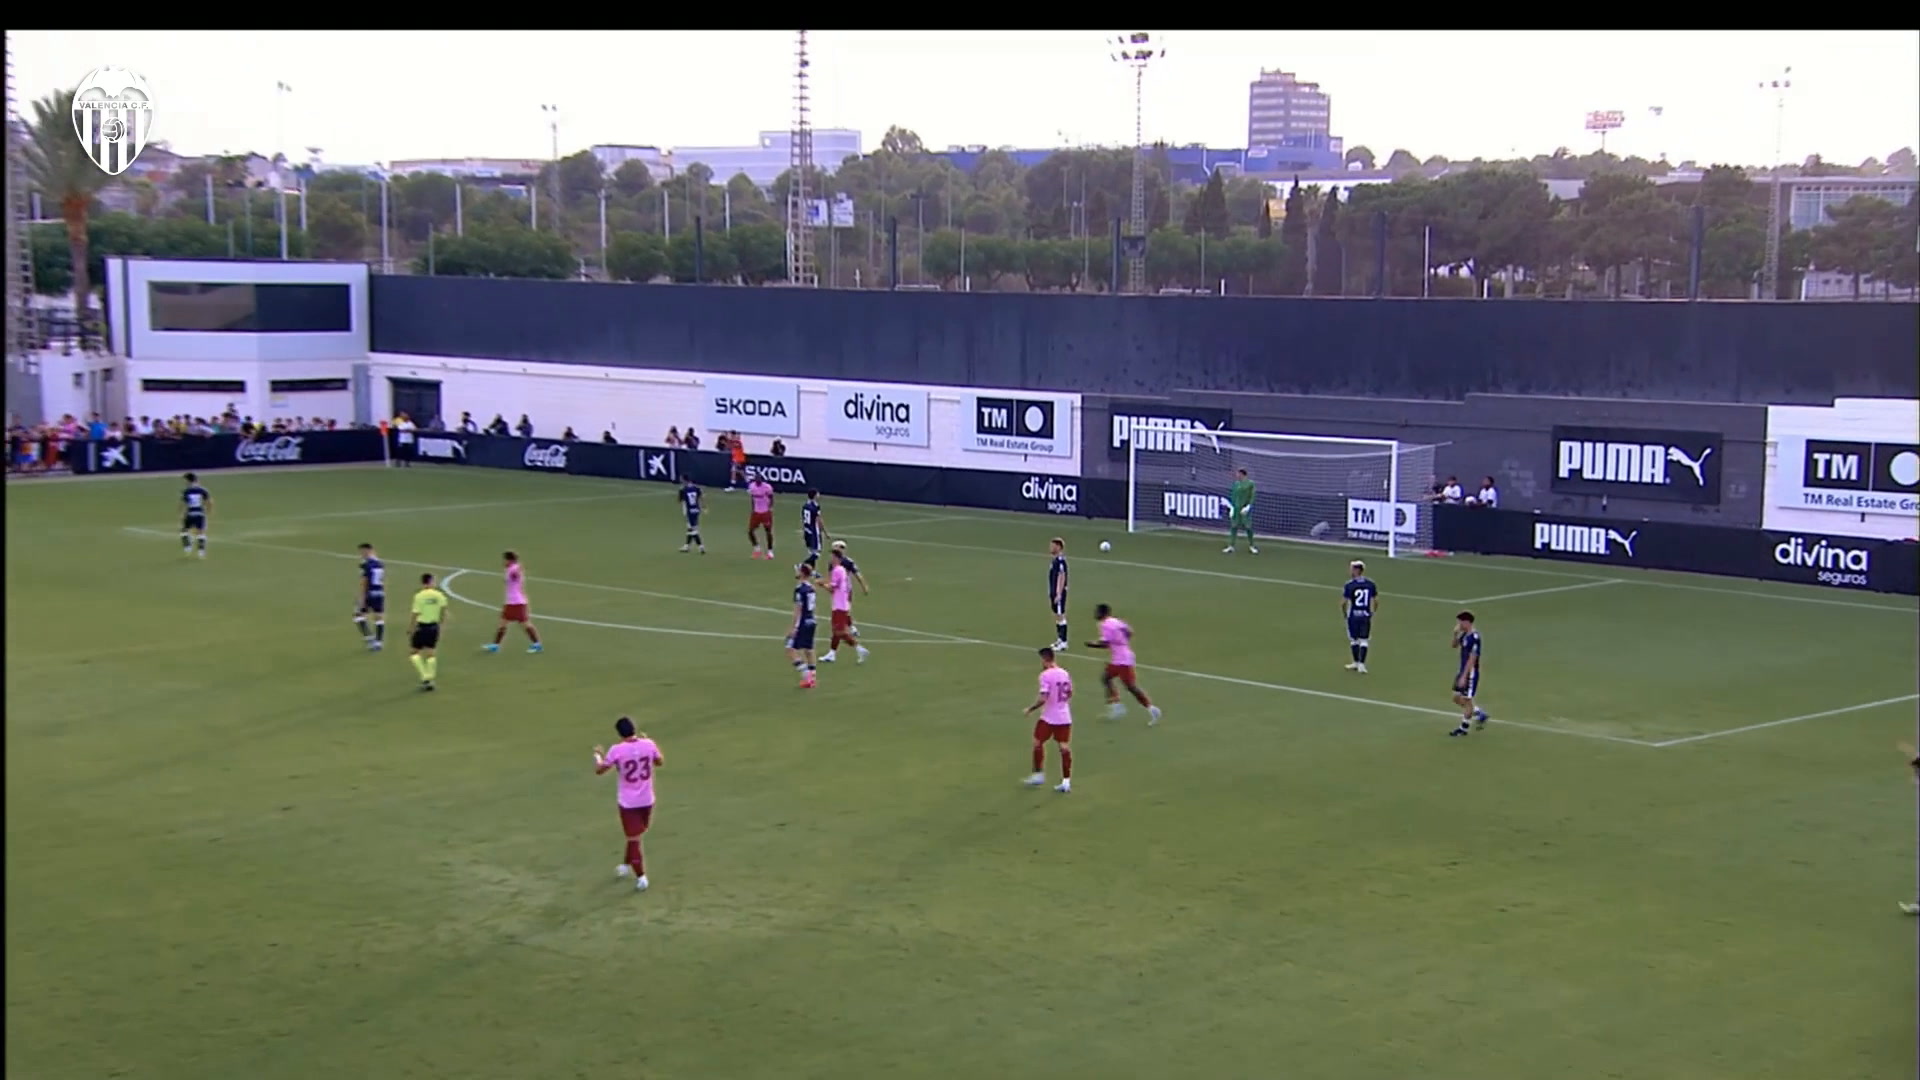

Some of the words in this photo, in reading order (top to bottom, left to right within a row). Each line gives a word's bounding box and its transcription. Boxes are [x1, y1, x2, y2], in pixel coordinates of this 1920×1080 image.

[844, 392, 910, 424] divina
[981, 407, 1008, 428] TM
[875, 425, 910, 439] seguros
[1113, 415, 1191, 452] PUMA
[976, 437, 988, 446] TM
[989, 438, 1005, 448] Real
[1006, 439, 1029, 450] Estate
[1030, 441, 1054, 453] Group
[1558, 440, 1666, 484] PUMA
[1813, 453, 1859, 480] TM
[1022, 476, 1077, 502] divina
[1047, 502, 1077, 514] seguros
[1163, 492, 1219, 519] PUMA
[1803, 493, 1823, 505] TM
[1825, 495, 1853, 506] Real
[1857, 496, 1897, 509] Estate
[1352, 508, 1375, 524] TM
[1534, 523, 1606, 554] PUMA
[1775, 537, 1868, 571] divina
[1817, 571, 1867, 585] seguros
[1354, 588, 1370, 607] 21
[1056, 682, 1073, 702] 19
[624, 756, 652, 784] 23
